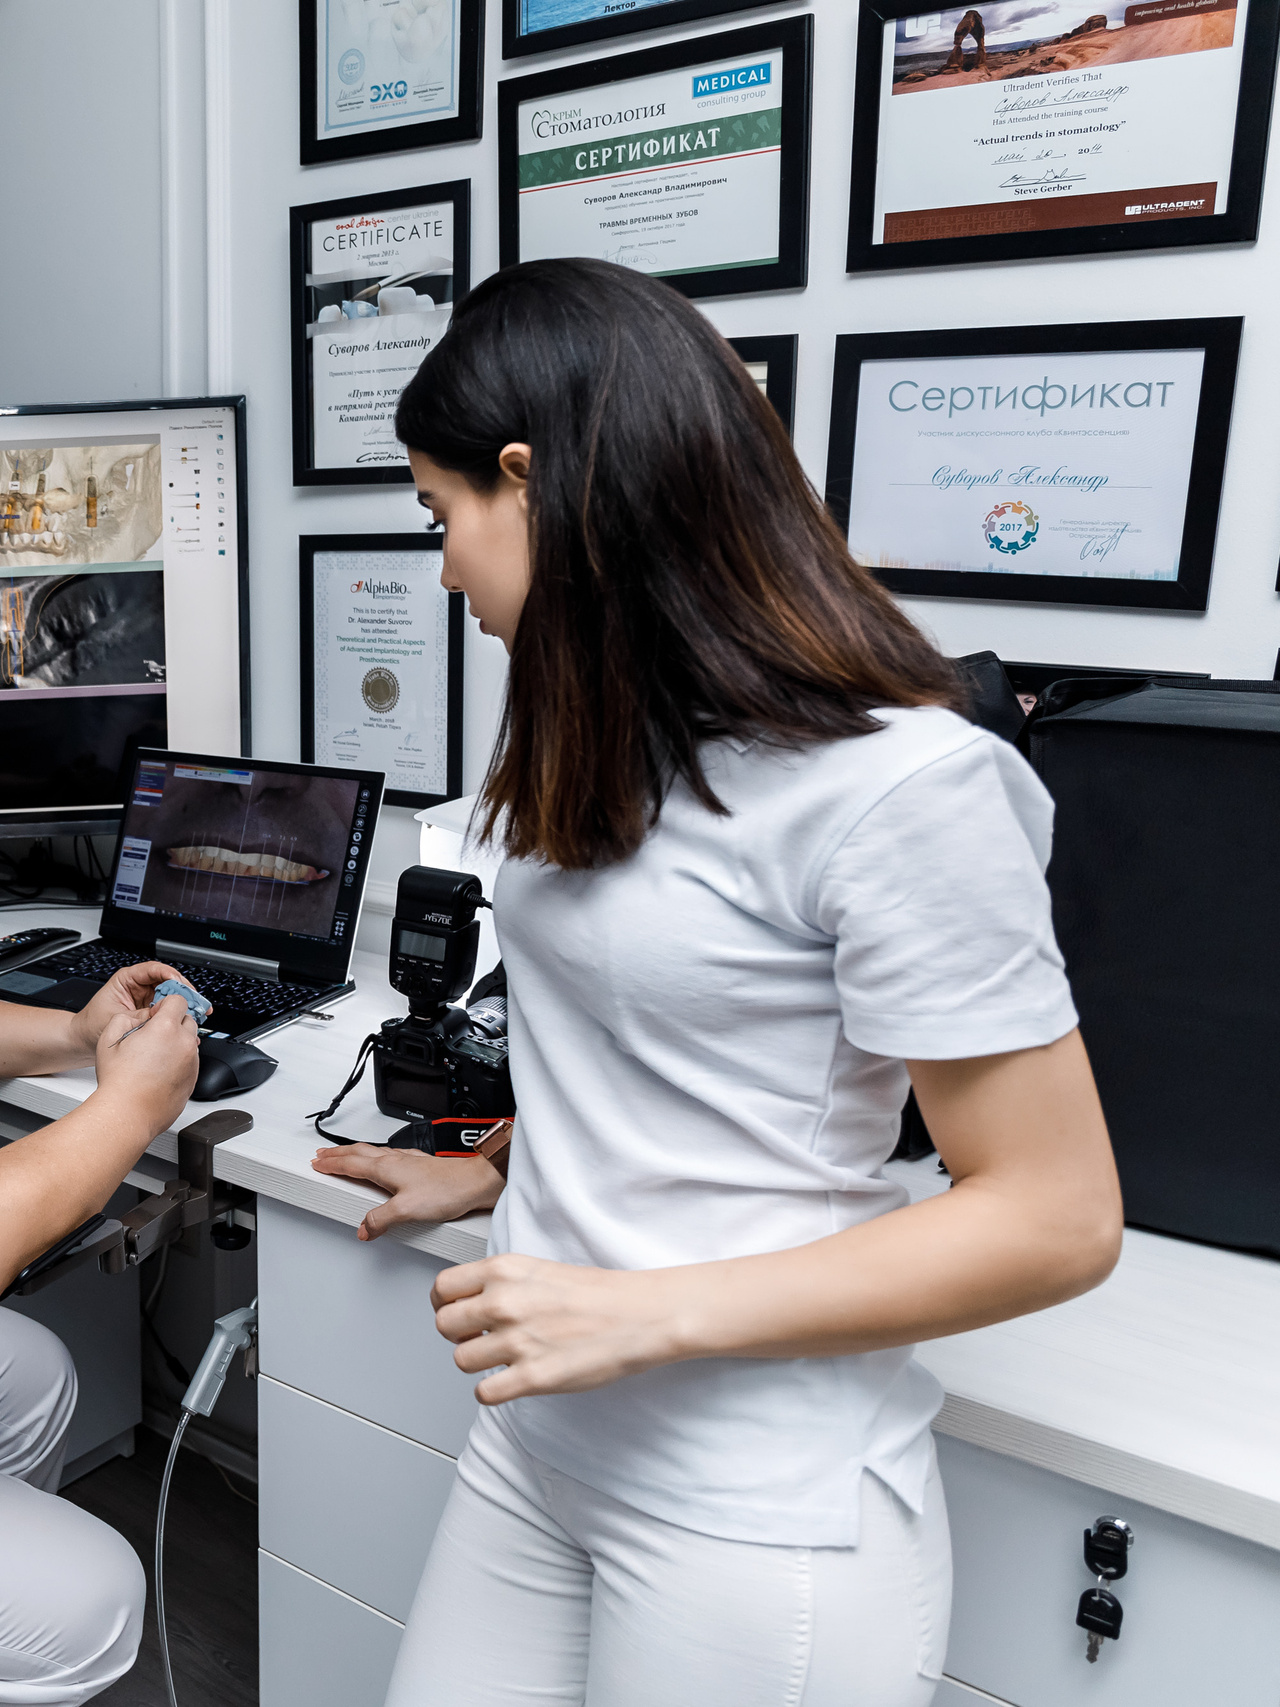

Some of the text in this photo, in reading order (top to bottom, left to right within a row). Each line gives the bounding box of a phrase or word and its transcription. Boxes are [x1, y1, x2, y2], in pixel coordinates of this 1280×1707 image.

[604, 1, 636, 13] Лектор
[1177, 2, 1195, 10] health
[697, 68, 767, 93] MEDICAL
[1003, 72, 1103, 93] Ultradent Verifies That
[697, 89, 767, 109] consulting group
[552, 108, 582, 122] КРЫМ
[992, 106, 1109, 126] Has Attended the training course
[1011, 131, 1043, 142] trends
[1045, 130, 1056, 138] in
[575, 127, 720, 171] СЕРТИФИКАТ
[584, 177, 728, 206] Суворов Александр Владимирович
[1014, 183, 1073, 196] Steve Gerber
[1142, 199, 1205, 211] ULTRADENT
[356, 216, 385, 228] design
[388, 213, 411, 223] center
[412, 209, 439, 220] ukraine
[599, 208, 698, 230] ТРАВМЫ ВРЕМЕННЫХ ЗУБОВ
[323, 220, 443, 252] CERTIFICATE
[328, 336, 431, 358] Суворов Александр
[348, 389, 374, 400] «Путь
[888, 375, 1176, 419] Сертификат
[334, 401, 373, 412] непрямой
[338, 412, 386, 423] Командный
[917, 429, 955, 438] Участник
[955, 429, 1025, 438] дискуссионного
[1026, 428, 1053, 438] клуба
[931, 464, 1110, 493] Суворов Александр
[999, 523, 1023, 532] 2017
[377, 608, 395, 616] certify
[348, 616, 413, 626] Dr. Alexander Suvorov
[336, 636, 366, 644] Theoretical
[378, 637, 402, 645] Practical
[402, 638, 426, 647] Aspects
[346, 646, 373, 654] Advanced
[374, 646, 410, 656] Implantology
[359, 656, 400, 665] Prosthodontics
[210, 931, 226, 941] DELL
[406, 1110, 424, 1120] Canon
